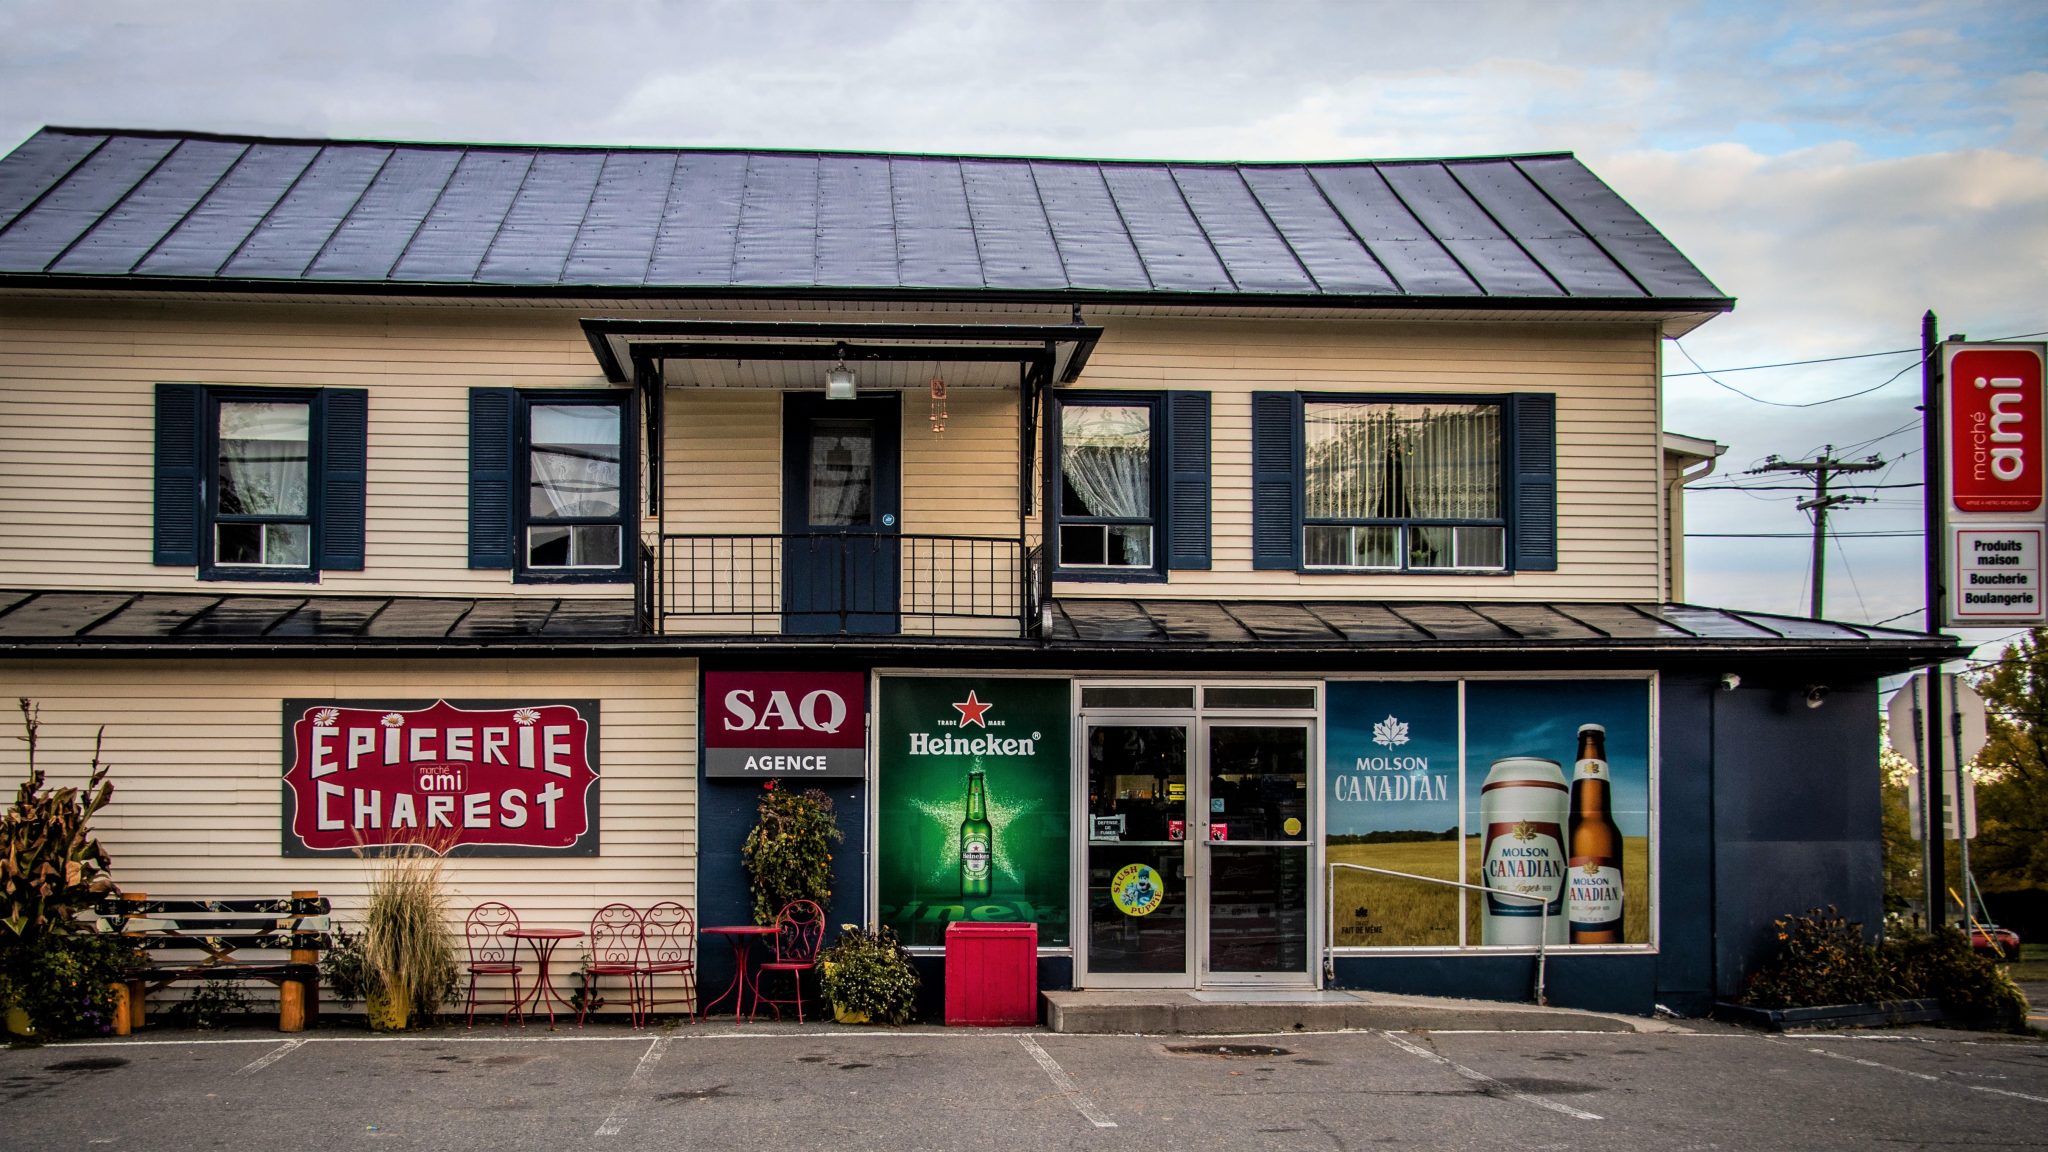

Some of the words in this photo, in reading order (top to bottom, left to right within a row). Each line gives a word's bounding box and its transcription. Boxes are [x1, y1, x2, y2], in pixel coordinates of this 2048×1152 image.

[1973, 376, 2024, 481] ami
[1970, 411, 1986, 481] marché
[1974, 540, 2023, 553] Produits
[1977, 554, 2020, 566] maison
[1970, 573, 2028, 585] Boucherie
[1965, 592, 2033, 605] Boulangerie
[724, 689, 847, 734] SAQ
[937, 719, 957, 727] TRADE
[987, 719, 1006, 727] MARK
[310, 725, 572, 779] EPICERIE
[419, 765, 450, 775] marché
[744, 755, 827, 771] AGENCE
[1356, 756, 1428, 771] MOLSON
[419, 769, 463, 792] ami
[1335, 774, 1448, 802] CANADIAN
[1502, 847, 1549, 857] MOLSON
[1489, 859, 1561, 878] CANADIAN
[1113, 865, 1138, 894] SLUSH
[1573, 877, 1609, 886] MOLSON
[1569, 887, 1618, 901] ANADIAN
[1130, 889, 1163, 915] PUPPIE
